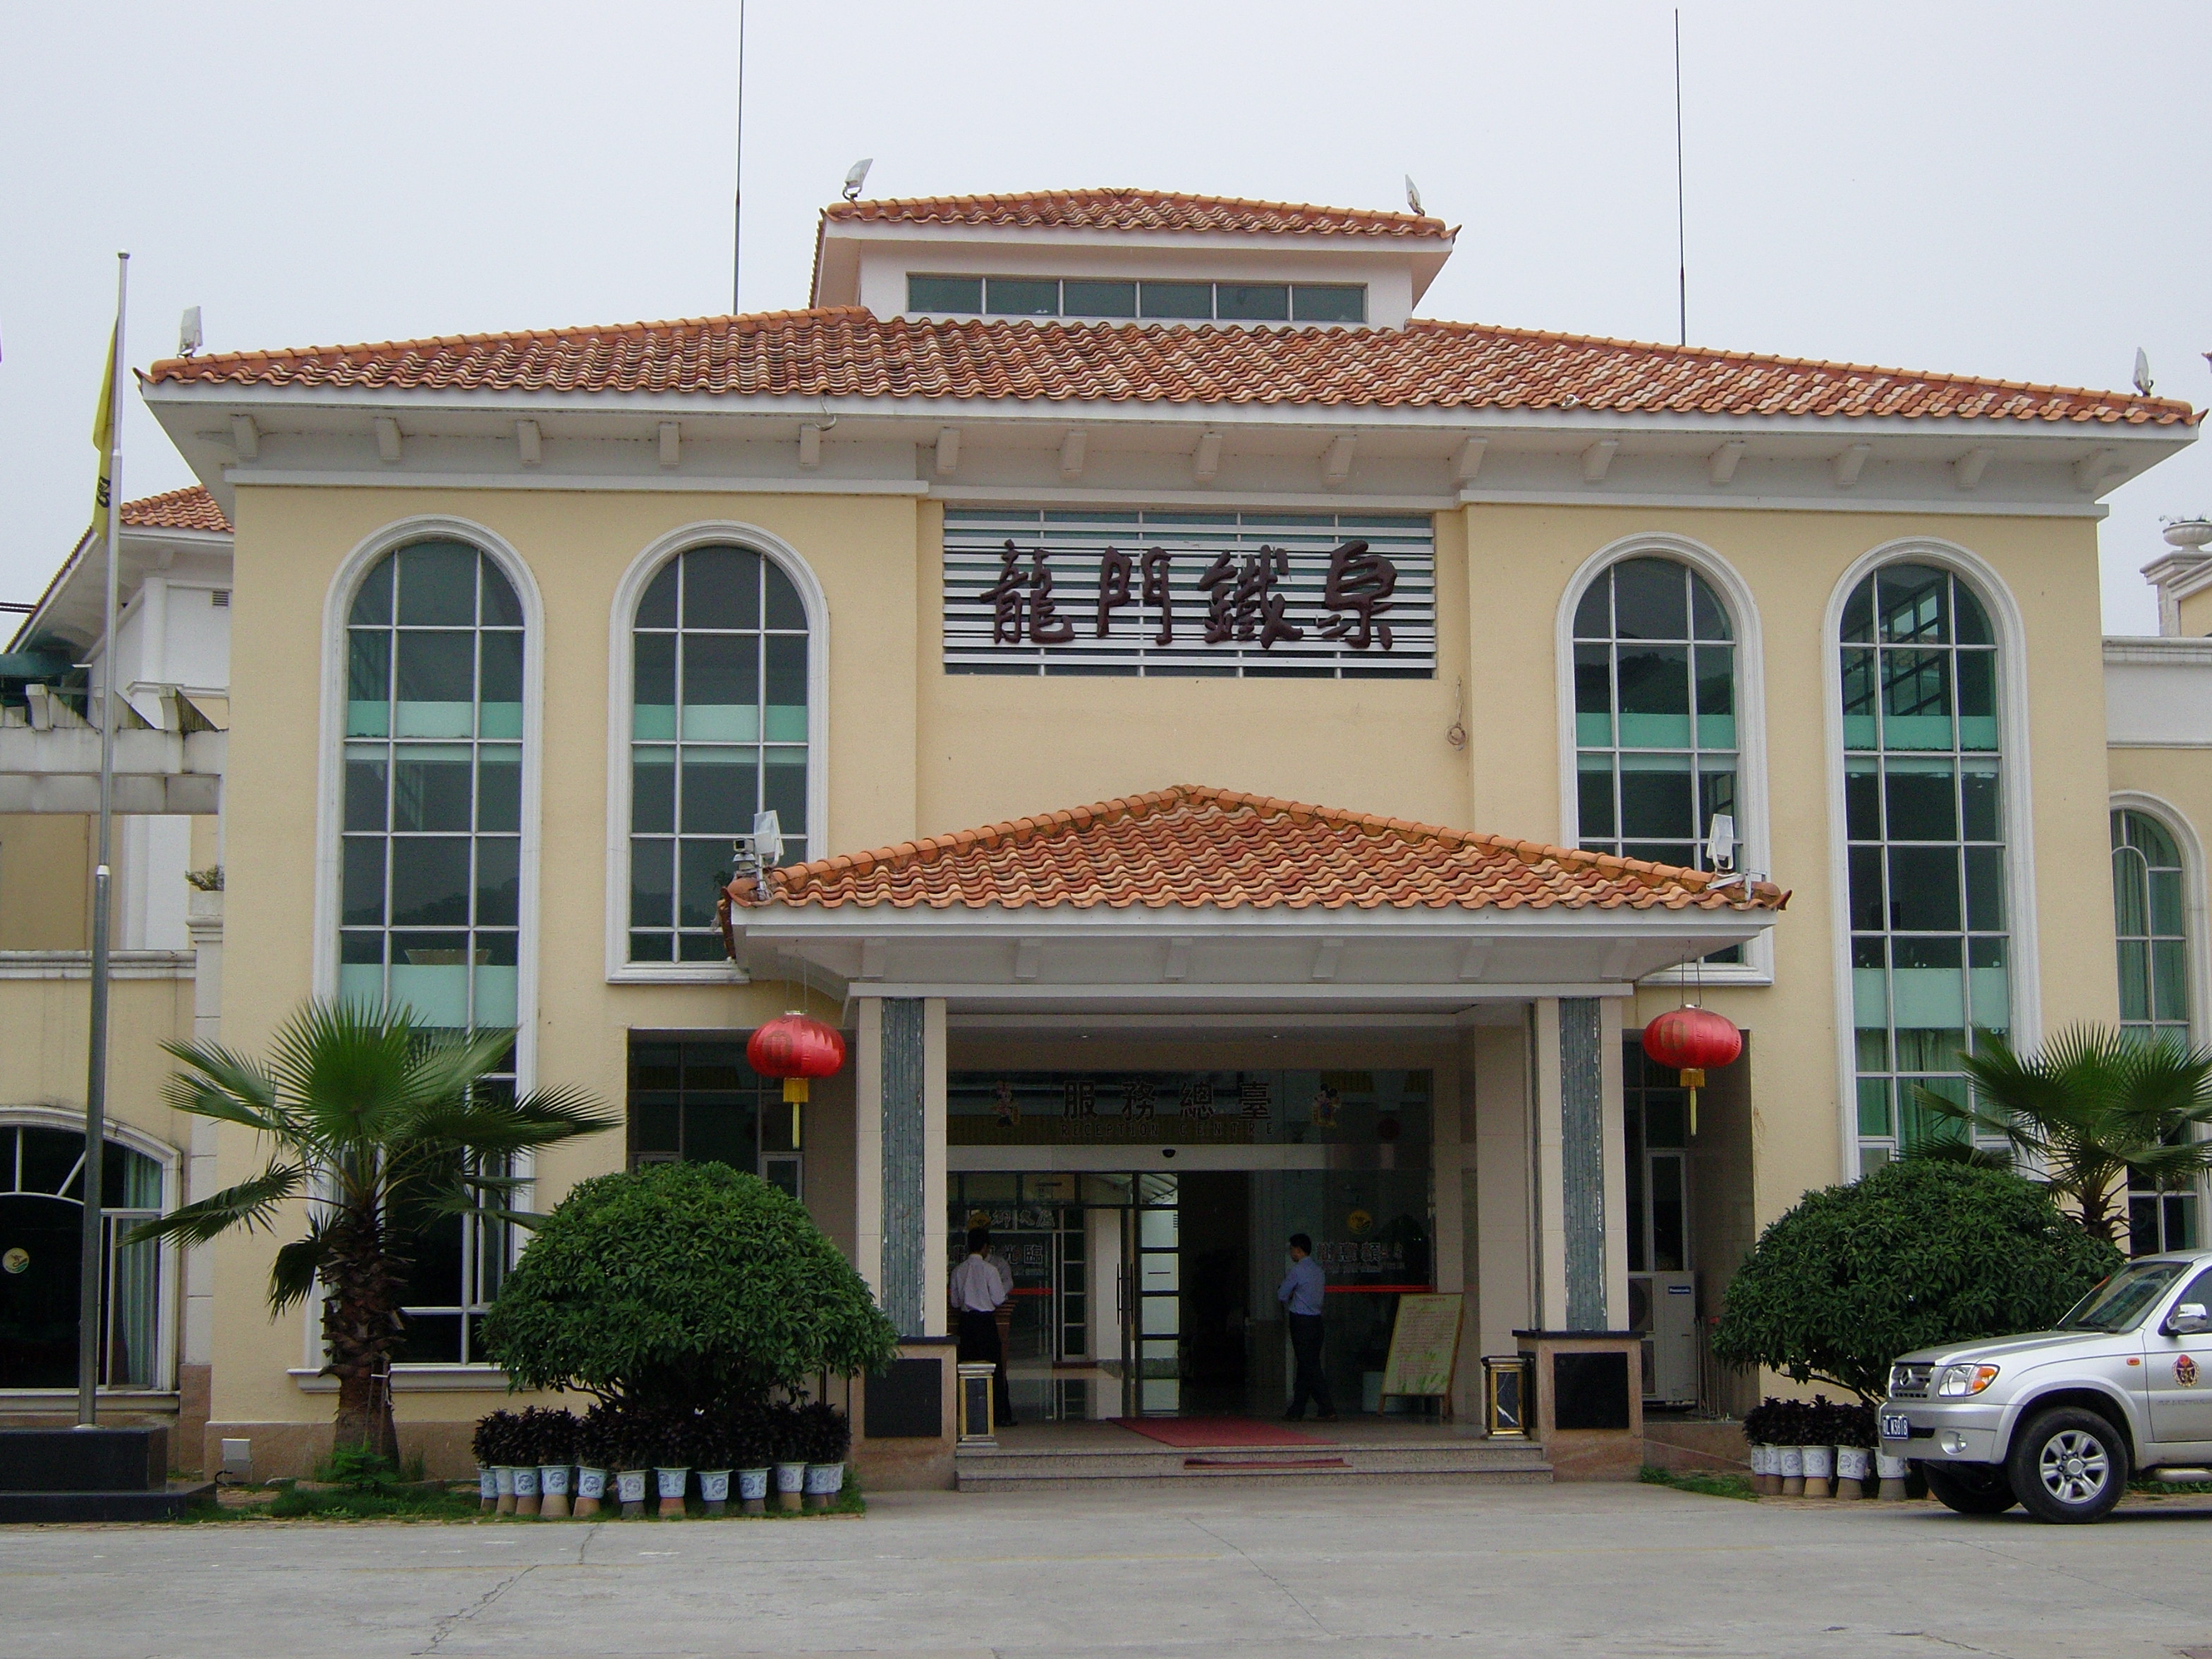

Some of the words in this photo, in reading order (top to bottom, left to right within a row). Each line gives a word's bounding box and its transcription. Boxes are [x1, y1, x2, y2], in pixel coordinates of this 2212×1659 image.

[980, 540, 1398, 650] 龍門鐵泉
[1063, 1081, 1272, 1121] 服務總臺
[1062, 1124, 1158, 1135] RECEPTION
[1180, 1124, 1272, 1135] CENTRE
